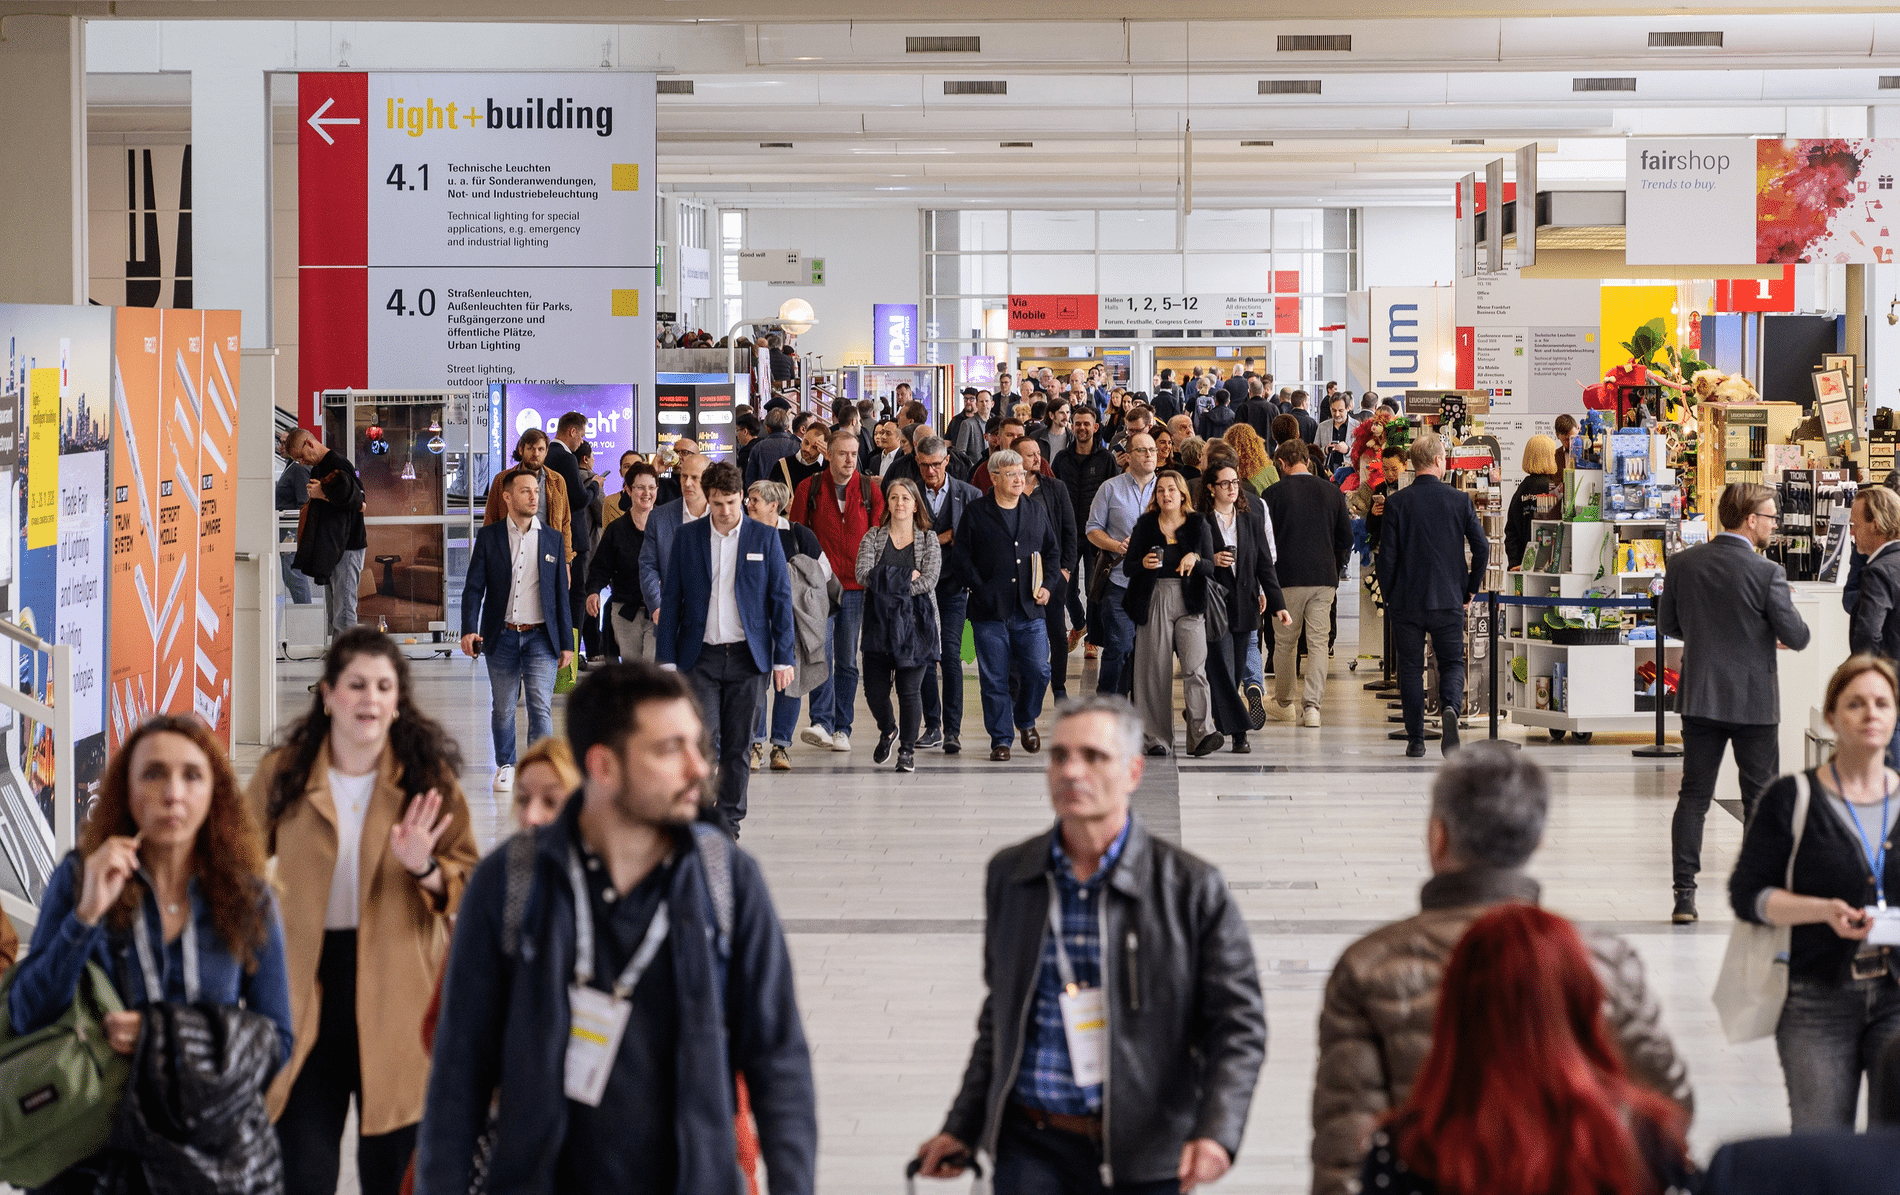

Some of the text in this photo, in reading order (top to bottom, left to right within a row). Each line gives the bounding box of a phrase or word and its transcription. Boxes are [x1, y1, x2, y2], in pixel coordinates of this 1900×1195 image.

[387, 97, 613, 137] light+building
[447, 163, 551, 173] Technische Leuchten
[1640, 150, 1730, 174] fairshop
[386, 163, 429, 191] 4.1
[447, 176, 596, 187] u. a. für Sonderanwendungen,
[1641, 178, 1716, 192] Trends to buy.
[447, 190, 599, 200] Not- und Industriebeleuchtung
[447, 211, 580, 223] Technical lighting for special
[447, 224, 581, 235] applications, e.g. emergency
[447, 237, 549, 248] and industrial lighting
[447, 289, 532, 299] Straßenleuchten,
[386, 288, 436, 317] 4.0
[447, 302, 573, 312] Außenleuchten für Parks,
[1012, 298, 1027, 307] Via
[1127, 297, 1138, 312] 1,
[1143, 297, 1157, 312] 2,
[447, 314, 545, 326] Fußgängerzone und
[1012, 311, 1046, 320] Mobile
[447, 327, 536, 339] öffentliche Plätze,
[1462, 333, 1468, 346] 1
[447, 341, 521, 352] Urban Lighting
[1377, 304, 1418, 399] lum
[447, 364, 516, 376] Street lighting,
[447, 377, 484, 387] outdoor
[486, 377, 522, 385] lighting
[524, 377, 537, 385] for
[698, 442, 716, 451] Driver
[1821, 471, 1841, 480] TROIKA
[62, 487, 77, 516] Trade
[78, 486, 88, 513] Fair
[115, 513, 131, 532] TRUNK
[160, 526, 178, 546] MODULE
[60, 531, 89, 567] of Lighting
[114, 534, 134, 555] SYSTEM
[60, 575, 98, 608] and Intelligent
[72, 661, 94, 697] nologies
